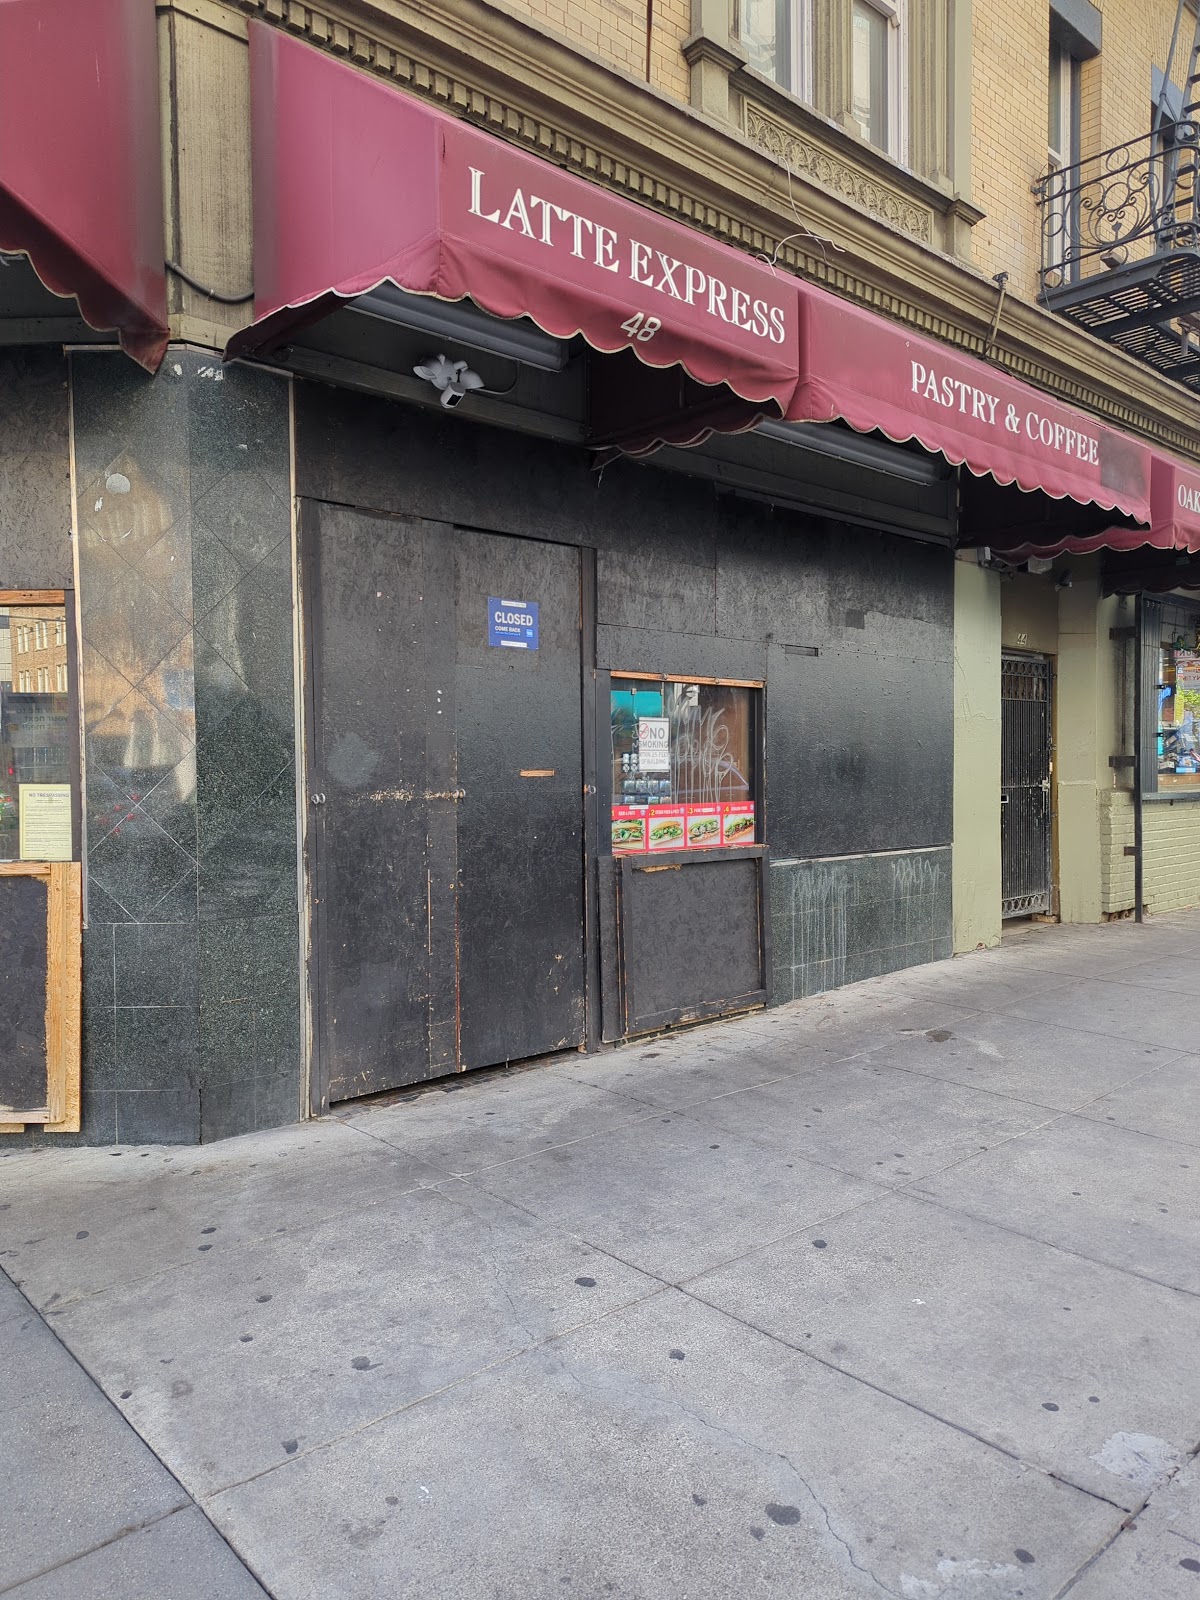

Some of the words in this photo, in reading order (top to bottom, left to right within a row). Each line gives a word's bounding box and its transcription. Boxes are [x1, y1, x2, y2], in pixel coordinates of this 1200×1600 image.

[467, 165, 621, 274] LATTE
[628, 237, 786, 345] EXPRESS
[620, 311, 662, 342] 48
[910, 360, 1001, 426] PASTRY
[1004, 403, 1021, 435] &
[1025, 411, 1100, 467] COFFEE
[1177, 484, 1200, 514] OAK
[494, 611, 533, 626] CLOSED
[1016, 633, 1028, 645] 44
[649, 727, 665, 739] NO
[639, 740, 669, 749] SMOKING
[647, 758, 667, 766] BUILDING
